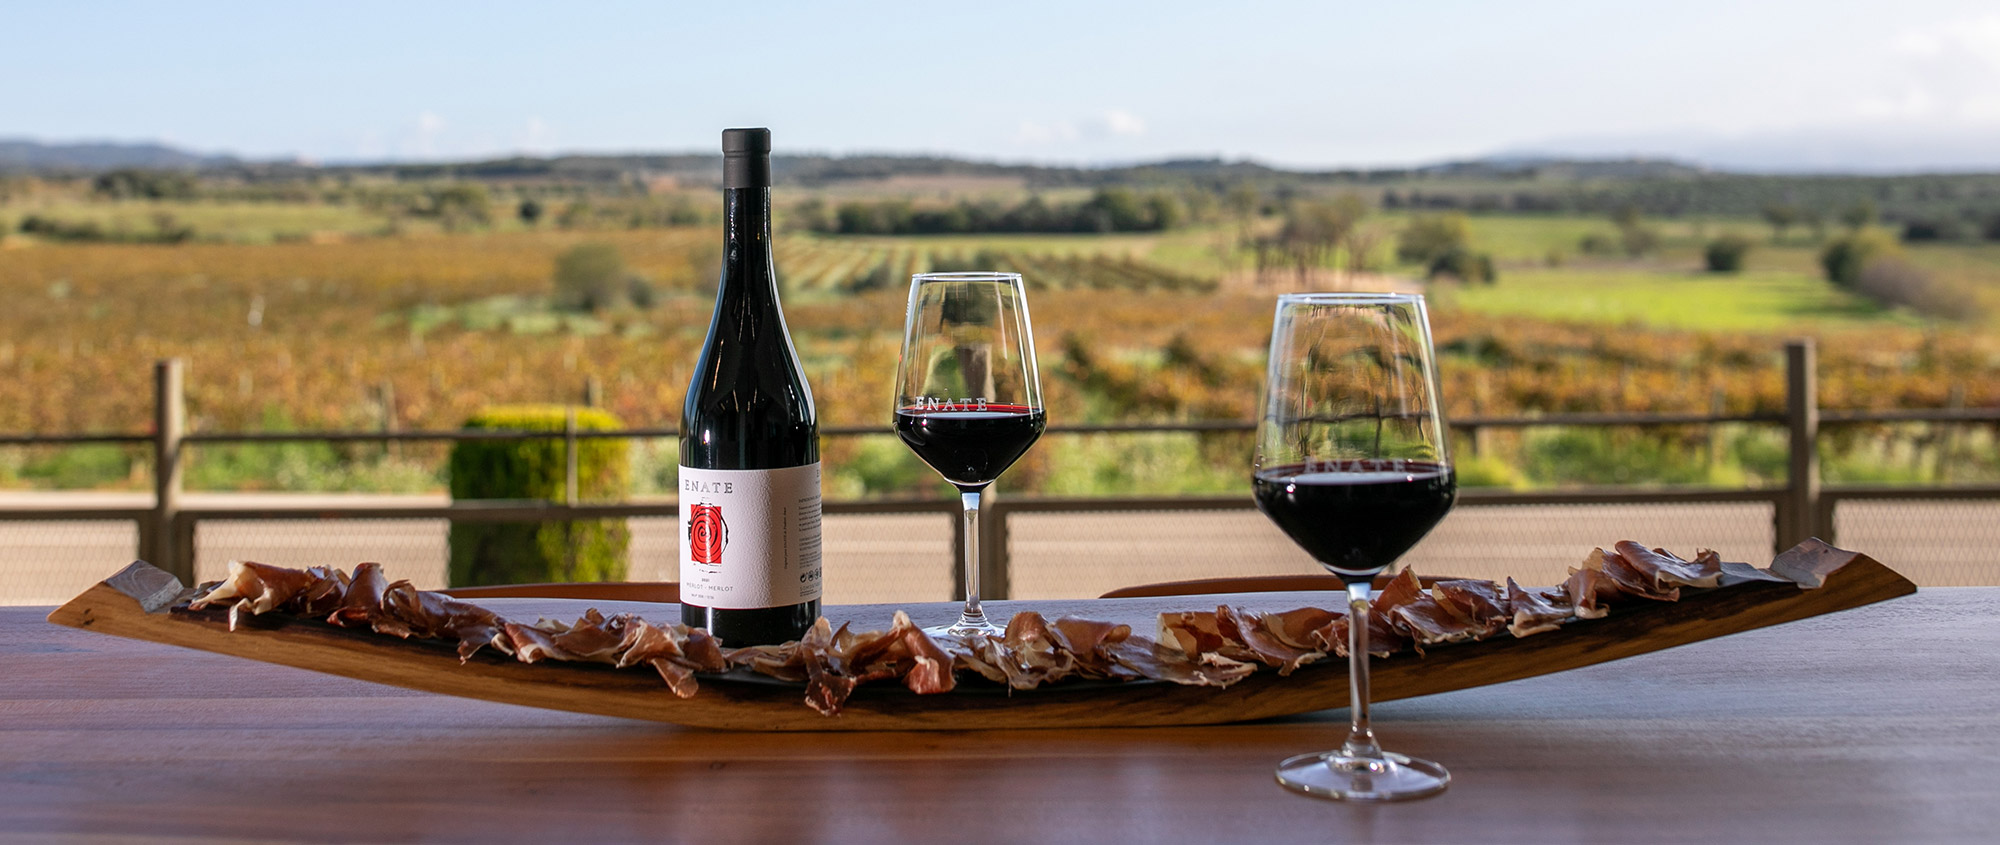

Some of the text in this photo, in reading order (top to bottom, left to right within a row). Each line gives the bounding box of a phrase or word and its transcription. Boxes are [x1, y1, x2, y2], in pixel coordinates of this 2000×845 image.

[915, 396, 988, 412] ENATE
[1303, 455, 1406, 474] ENATE
[684, 479, 733, 494] ENATE
